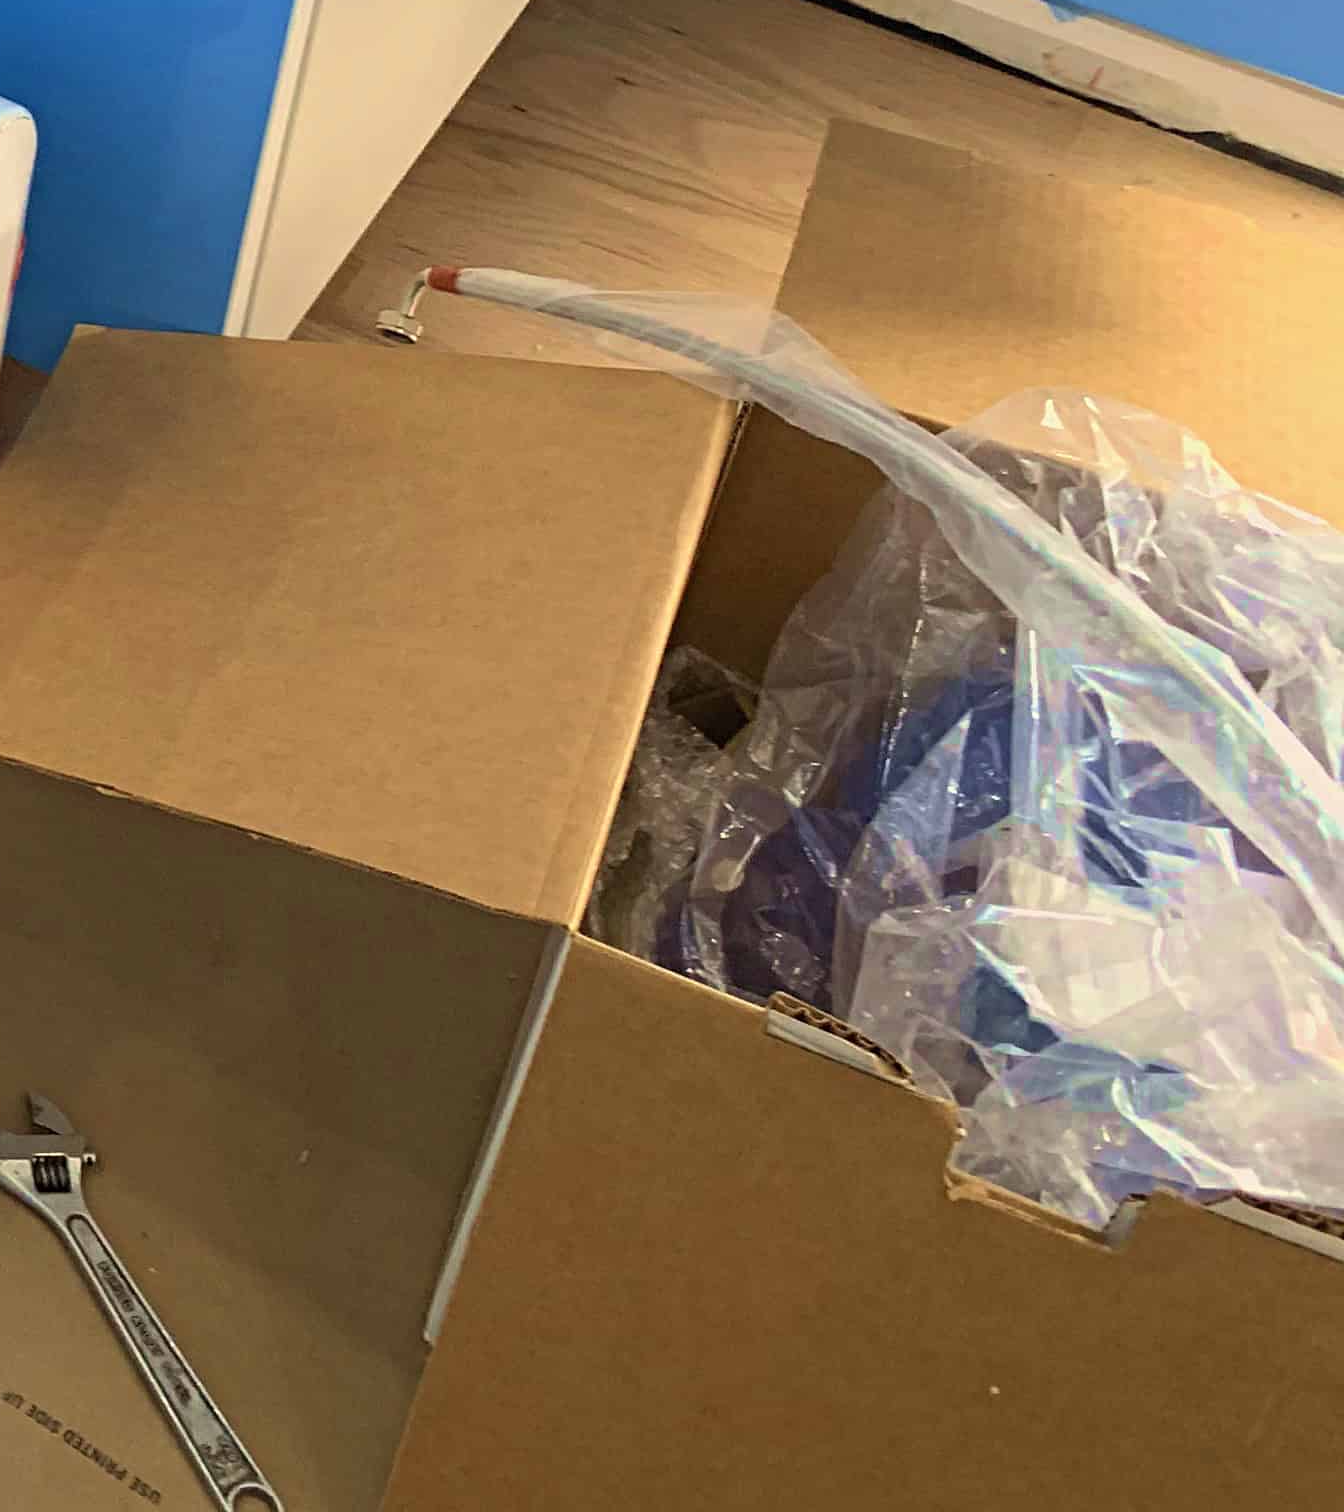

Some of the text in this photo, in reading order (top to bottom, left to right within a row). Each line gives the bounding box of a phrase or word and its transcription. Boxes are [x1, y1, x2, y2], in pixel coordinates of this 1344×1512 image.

[1, 1391, 162, 1506] USE PRINTED SIDE UP
